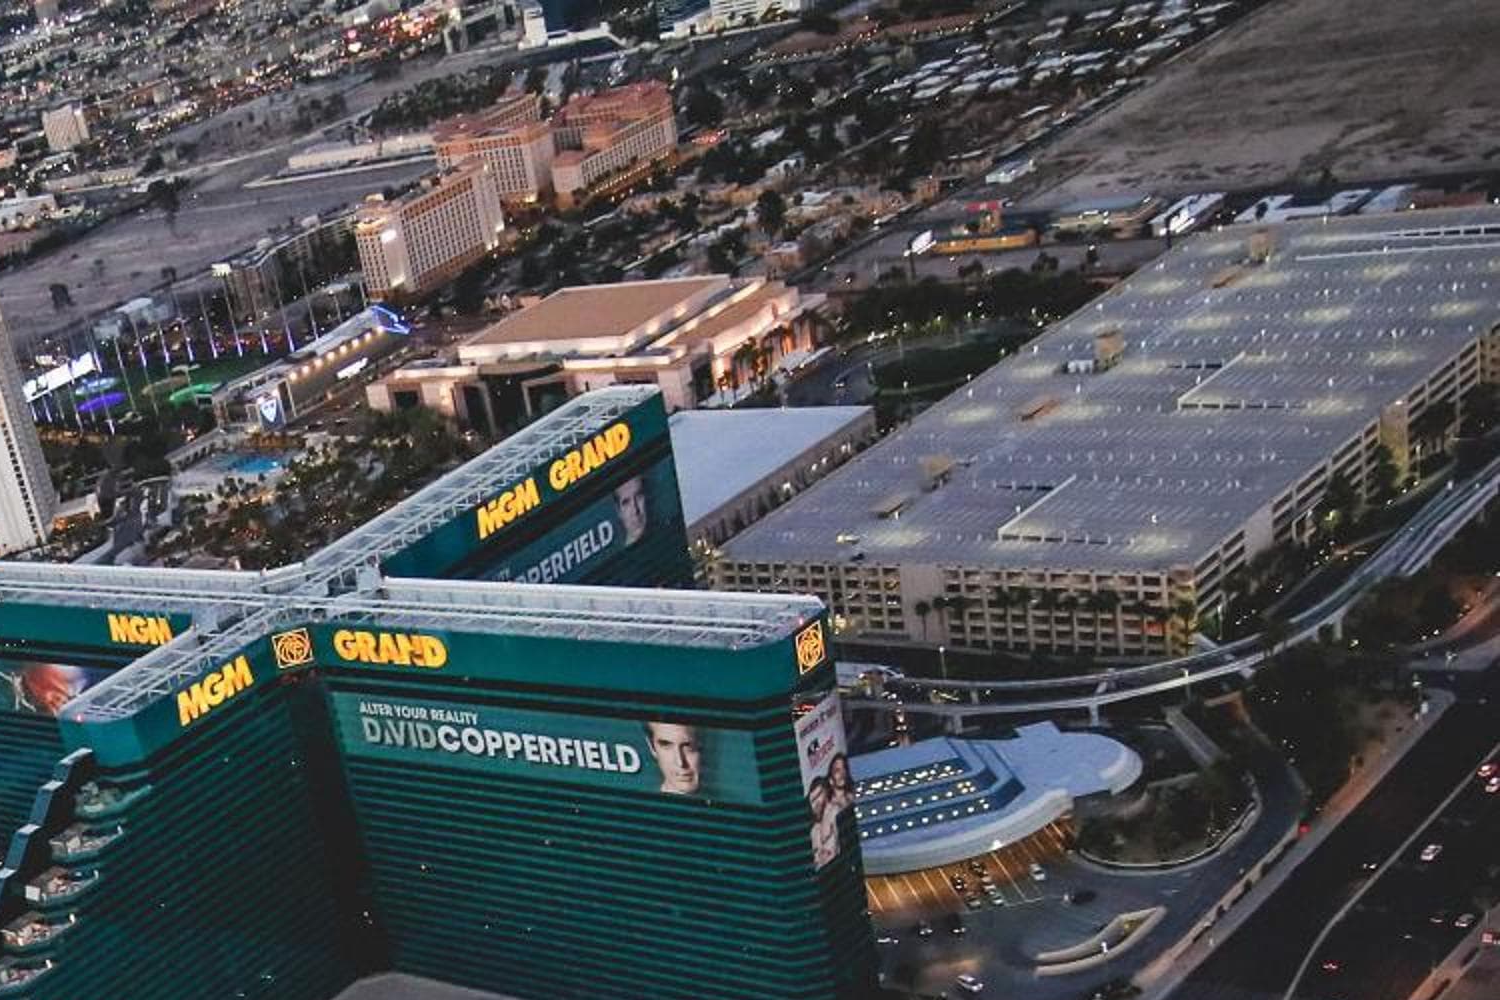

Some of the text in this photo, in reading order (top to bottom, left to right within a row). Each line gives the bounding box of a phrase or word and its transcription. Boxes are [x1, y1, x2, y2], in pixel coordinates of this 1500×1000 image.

[476, 422, 631, 540] MGM GRAND
[107, 613, 173, 646] MGM
[176, 629, 448, 727] MGM GRAND
[359, 701, 479, 726] ALTER YOUR REALITY
